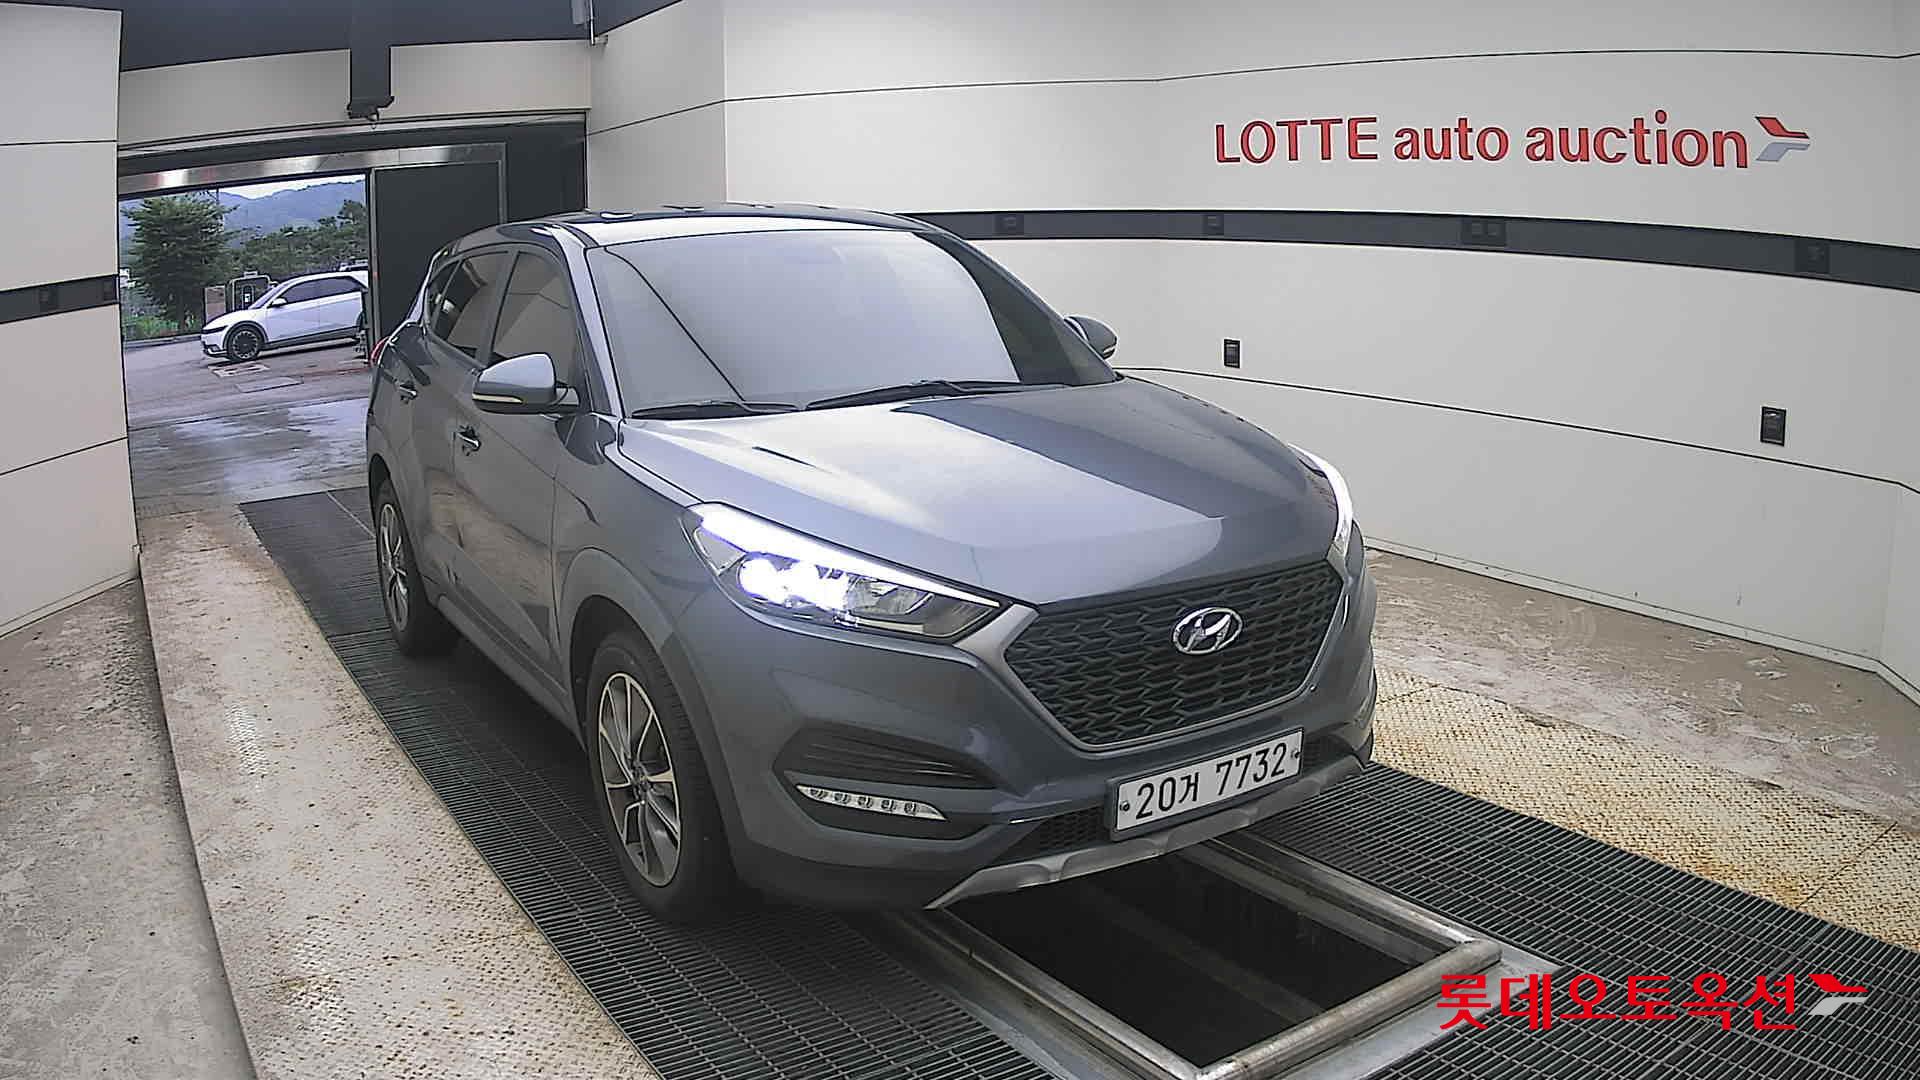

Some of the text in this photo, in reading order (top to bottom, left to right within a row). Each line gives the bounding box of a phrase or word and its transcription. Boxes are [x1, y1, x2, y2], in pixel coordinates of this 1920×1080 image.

[1214, 108, 1749, 169] LOTTE auto auction
[1135, 742, 1287, 820] 20거 7732
